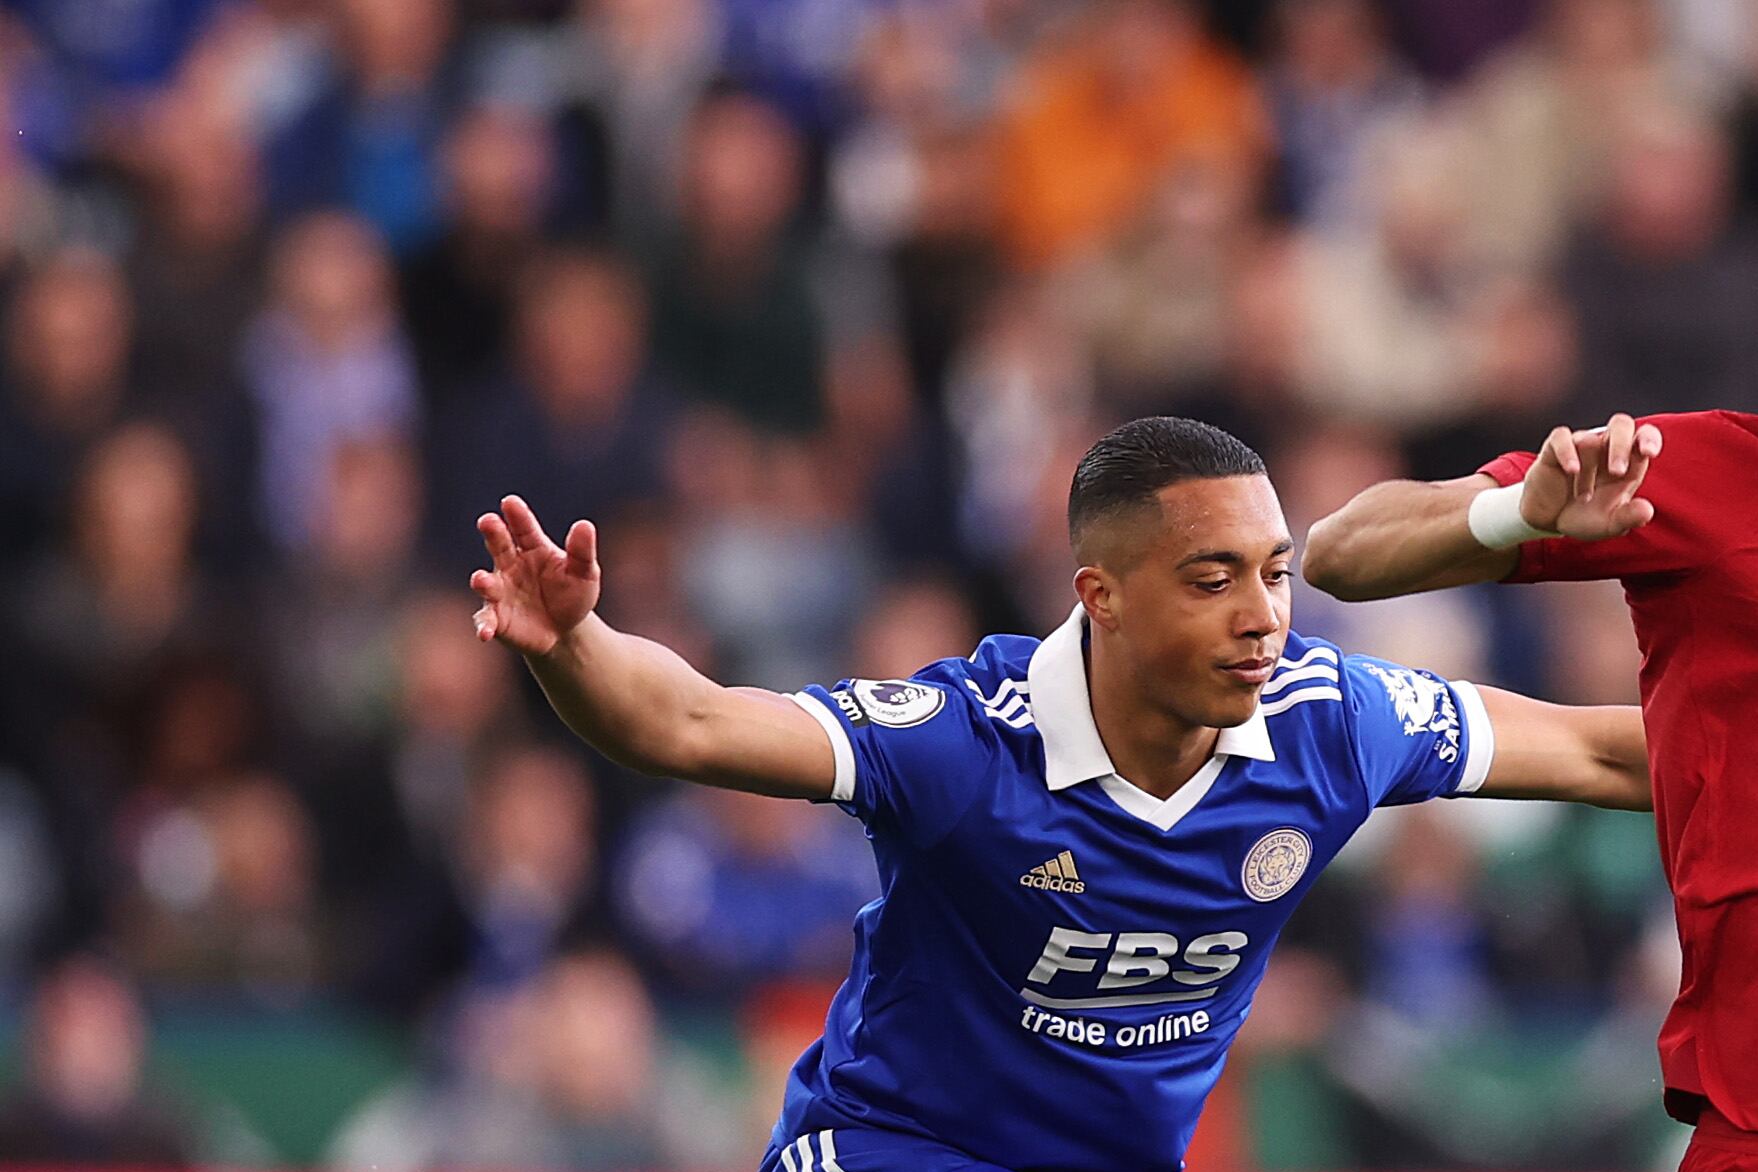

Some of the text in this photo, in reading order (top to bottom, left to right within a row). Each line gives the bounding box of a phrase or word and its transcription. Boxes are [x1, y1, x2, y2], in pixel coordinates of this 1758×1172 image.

[1020, 873, 1086, 894] adidas
[1026, 926, 1249, 990] FBS
[1020, 1005, 1210, 1047] trade online
